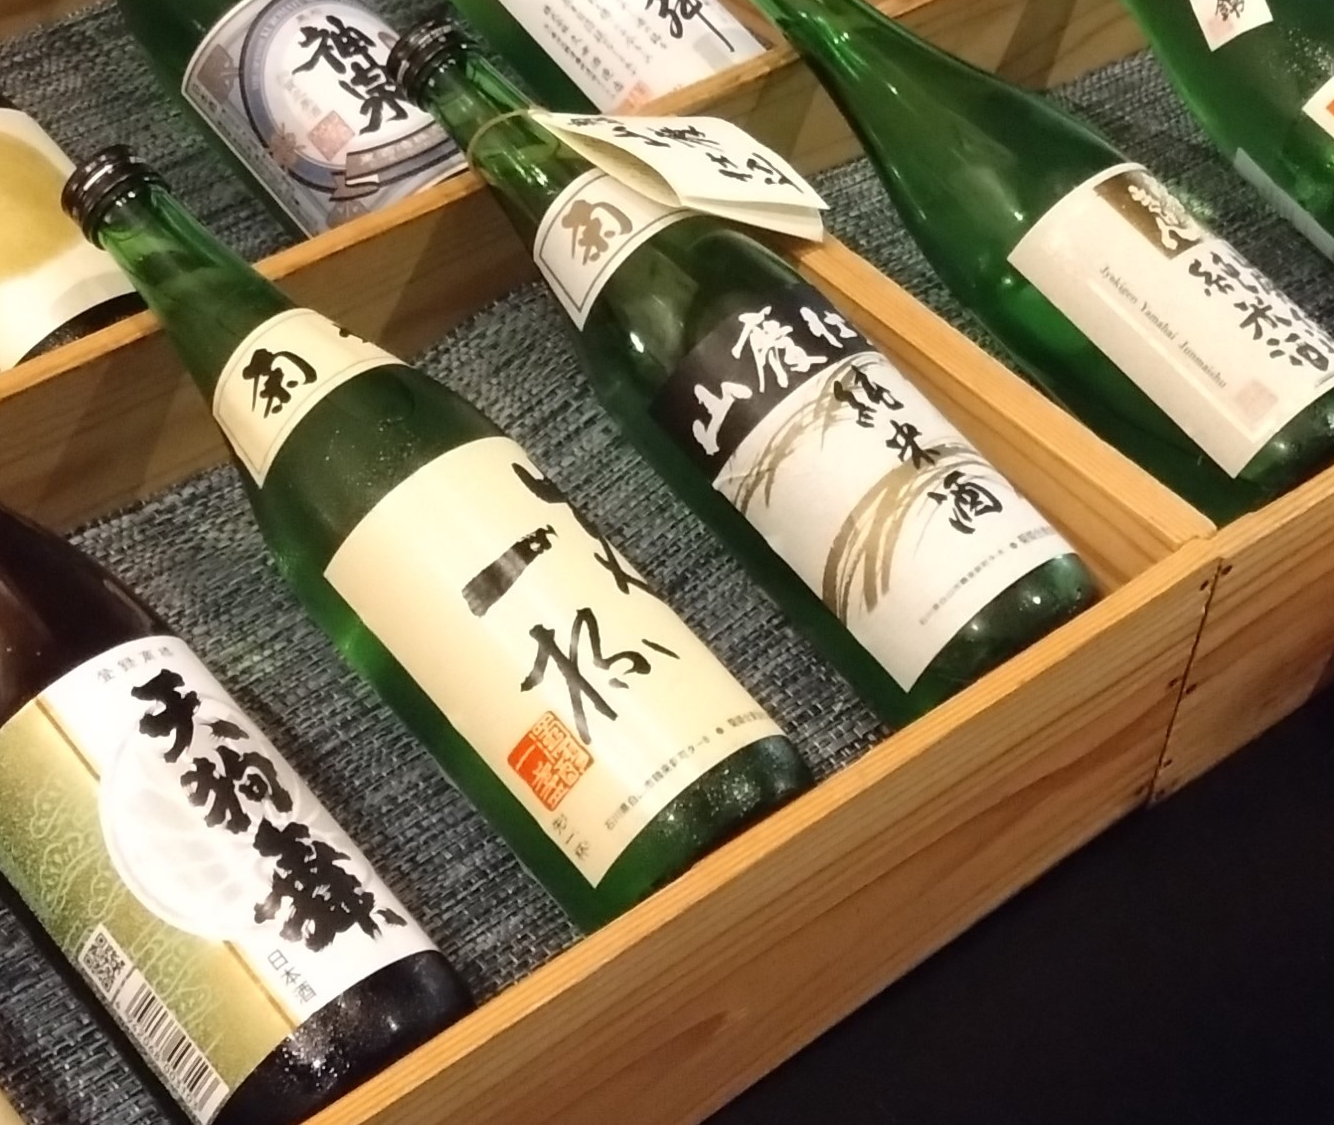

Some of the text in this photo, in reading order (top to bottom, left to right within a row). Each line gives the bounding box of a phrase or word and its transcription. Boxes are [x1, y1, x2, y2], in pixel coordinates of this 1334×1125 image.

[1139, 300, 1181, 342] Yamahai
[1187, 251, 1331, 372] 純米酒
[832, 364, 1004, 536] 純米酒
[130, 668, 409, 953] 天狗舞
[265, 948, 319, 1005] 日本酒
